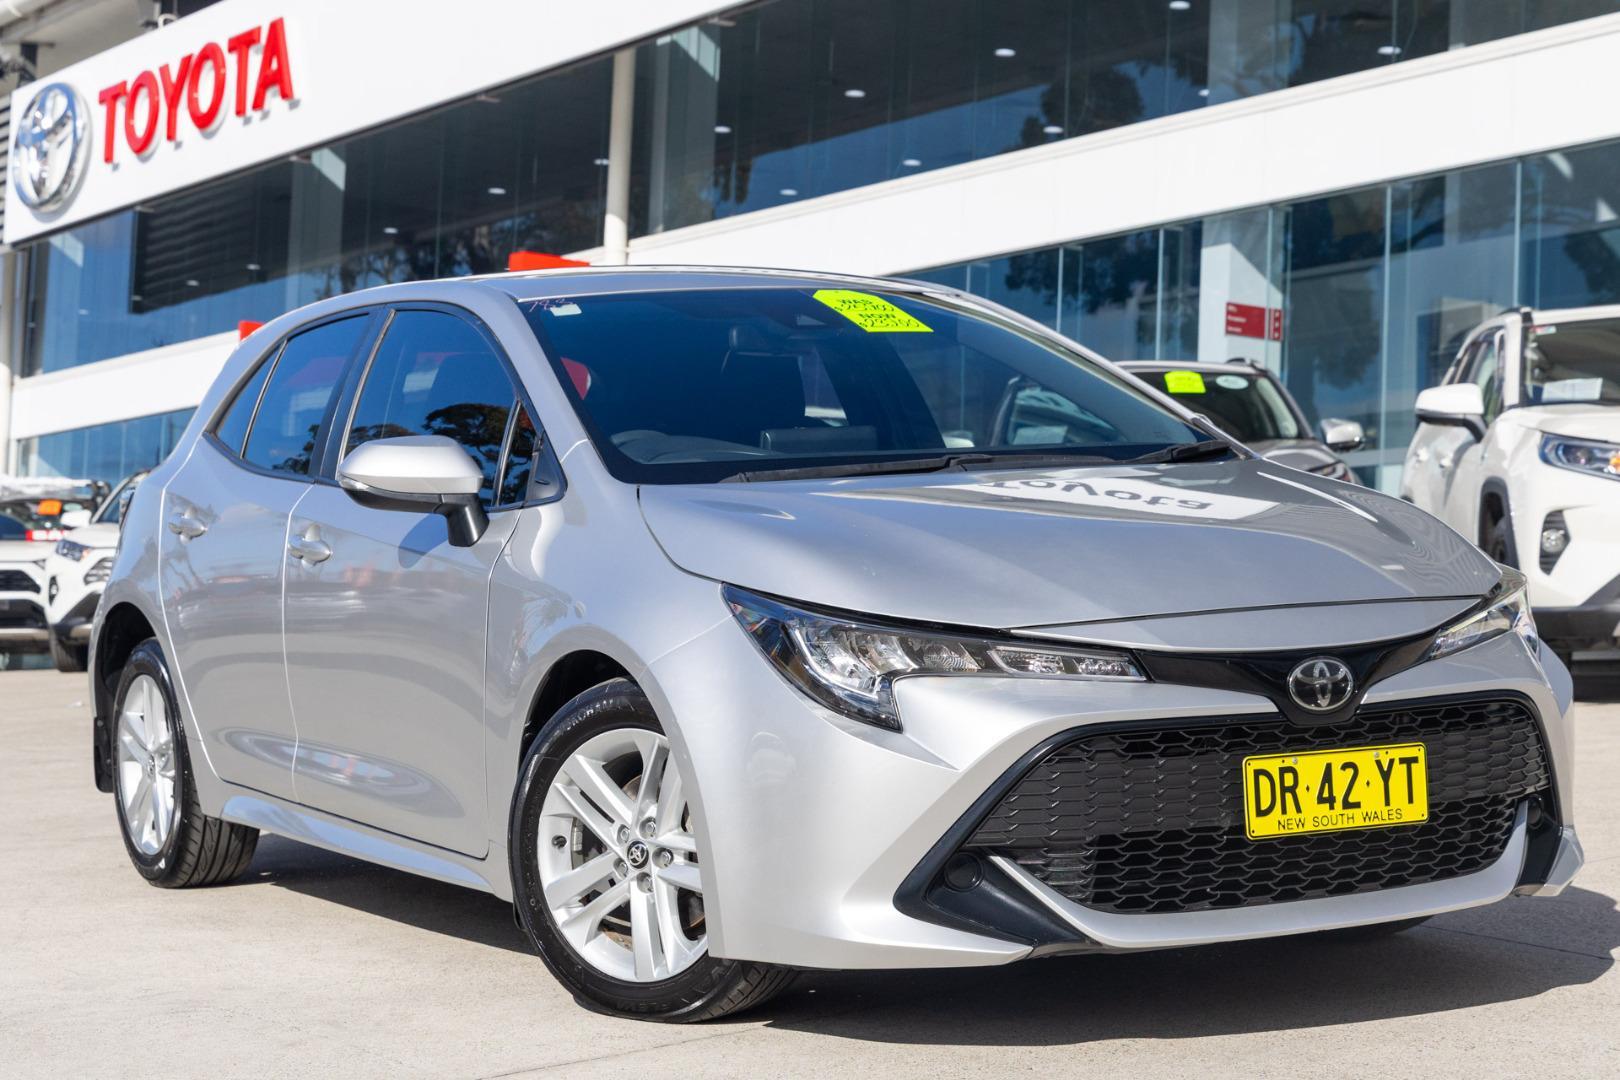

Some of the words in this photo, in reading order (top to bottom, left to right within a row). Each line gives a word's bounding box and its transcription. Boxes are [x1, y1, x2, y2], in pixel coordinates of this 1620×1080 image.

[98, 17, 295, 164] TOYOTA
[1277, 816, 1306, 831] NEW
[1312, 813, 1355, 828] SOUTH
[1361, 808, 1403, 823] WALES
